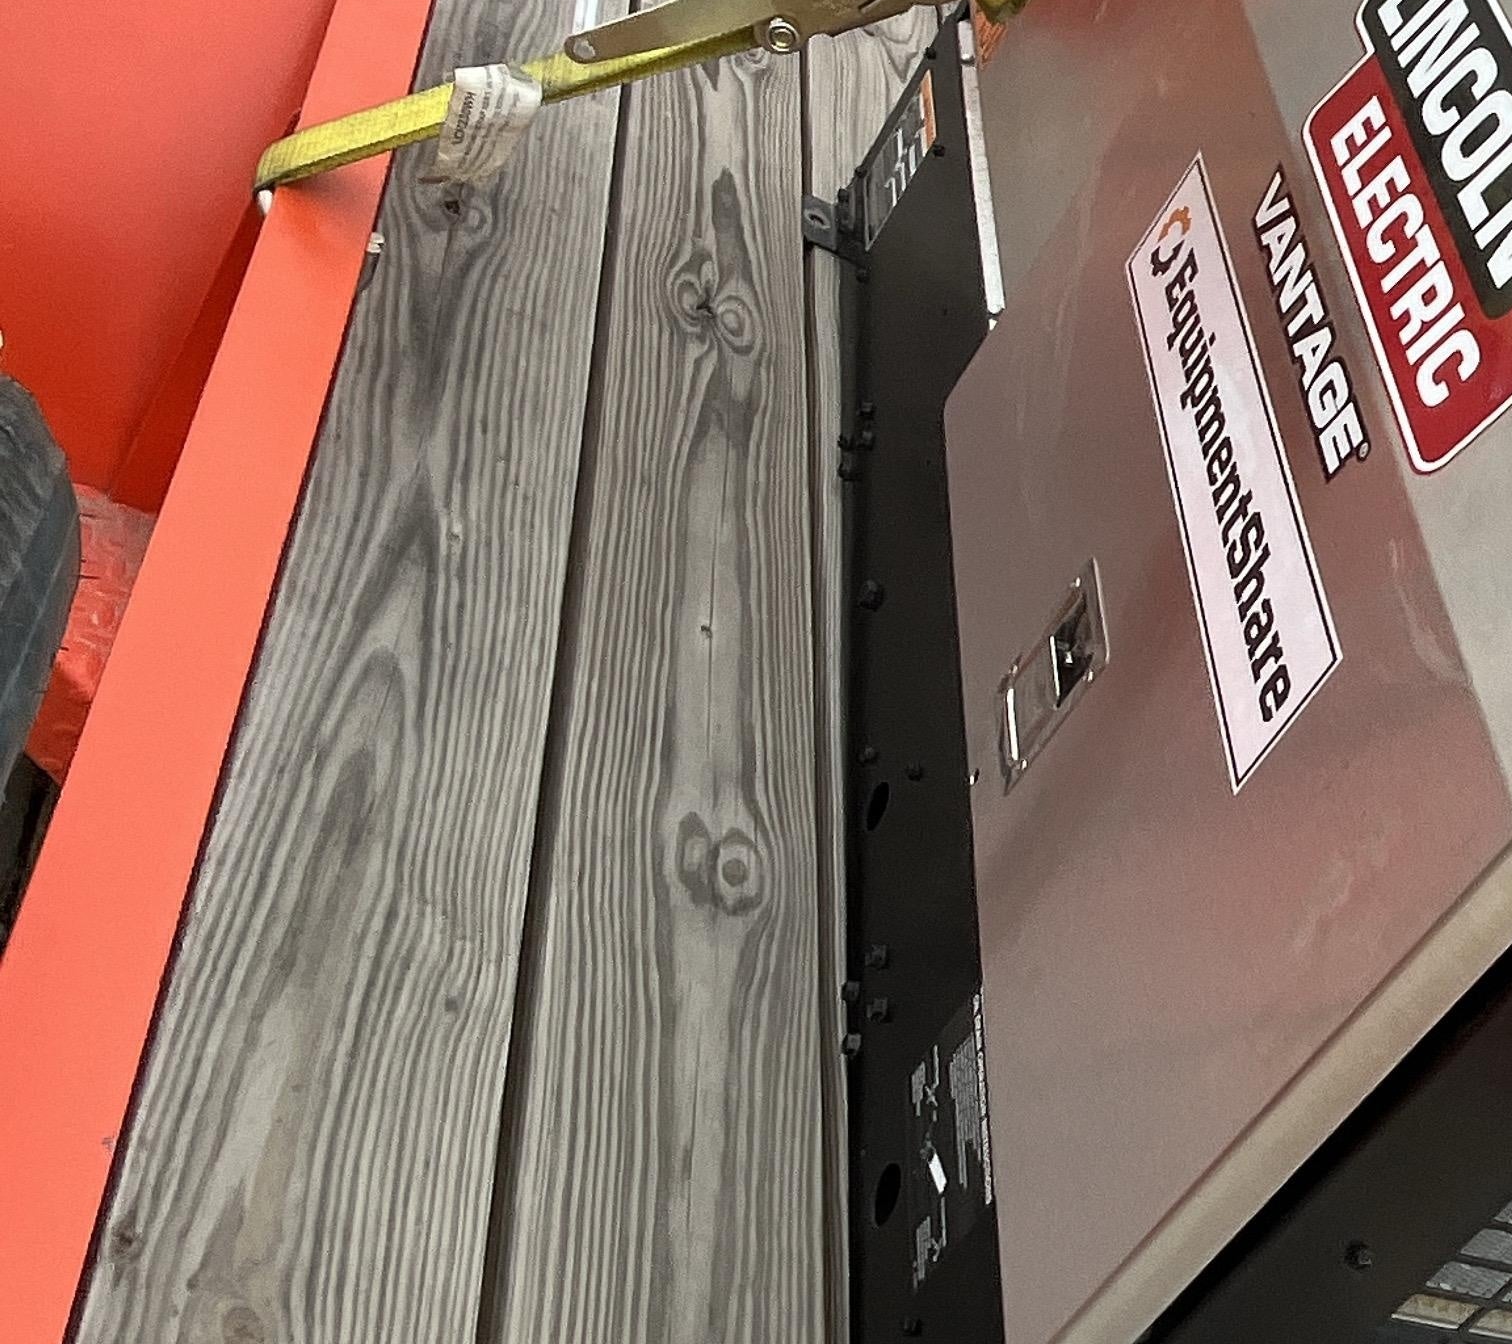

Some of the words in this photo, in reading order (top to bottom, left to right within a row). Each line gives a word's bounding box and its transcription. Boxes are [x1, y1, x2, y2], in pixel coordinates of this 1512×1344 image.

[1253, 166, 1359, 476] VANTAGE
[1330, 95, 1481, 408] ELECTRIC
[1163, 260, 1293, 724] EquipmentShare
